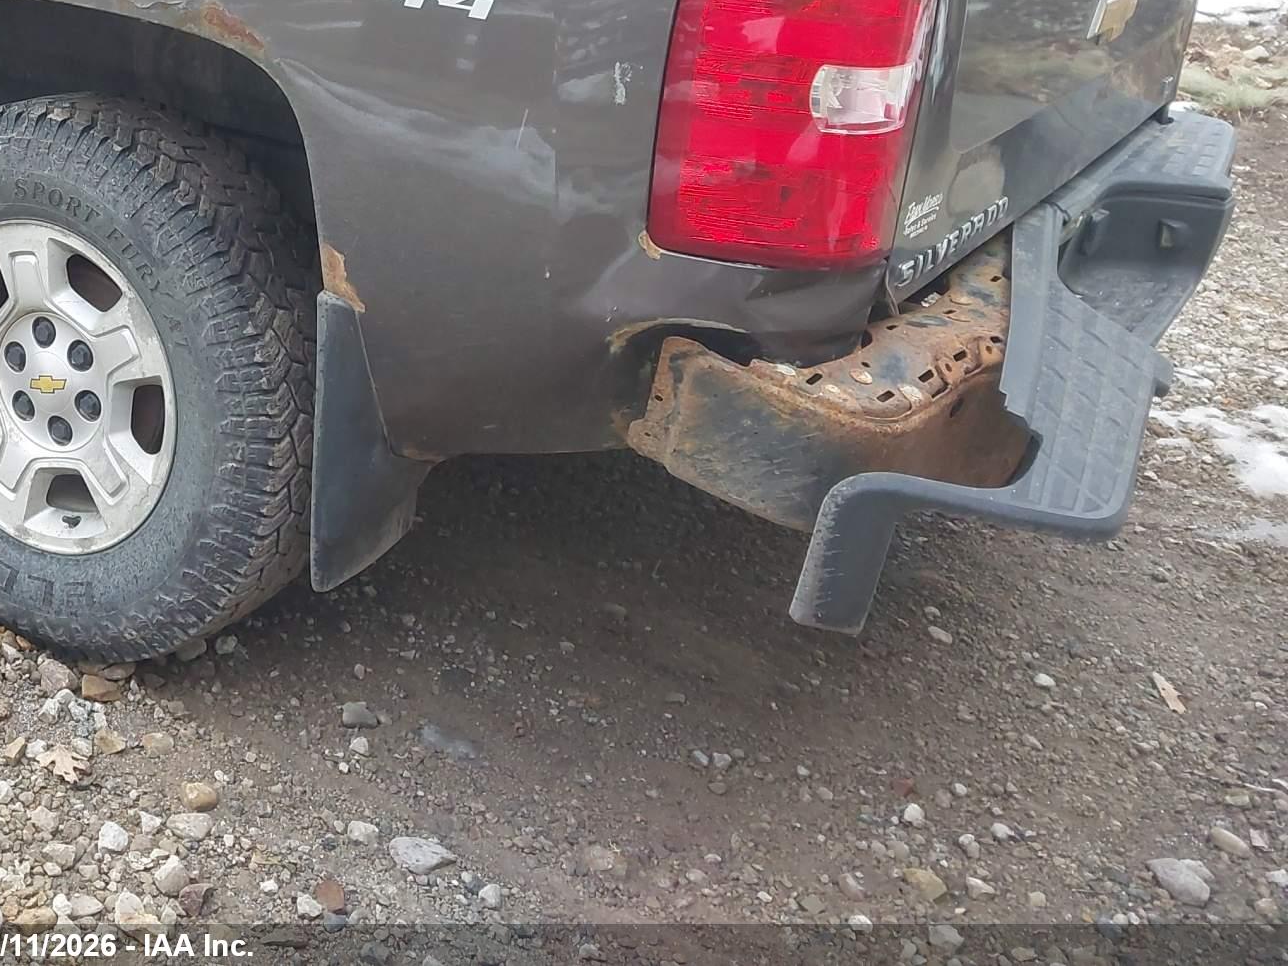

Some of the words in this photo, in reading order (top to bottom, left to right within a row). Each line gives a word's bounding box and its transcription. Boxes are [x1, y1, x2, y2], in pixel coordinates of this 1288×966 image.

[14, 178, 101, 223] SPORT
[105, 227, 172, 297] FURY
[895, 196, 1009, 287] SILVERADO
